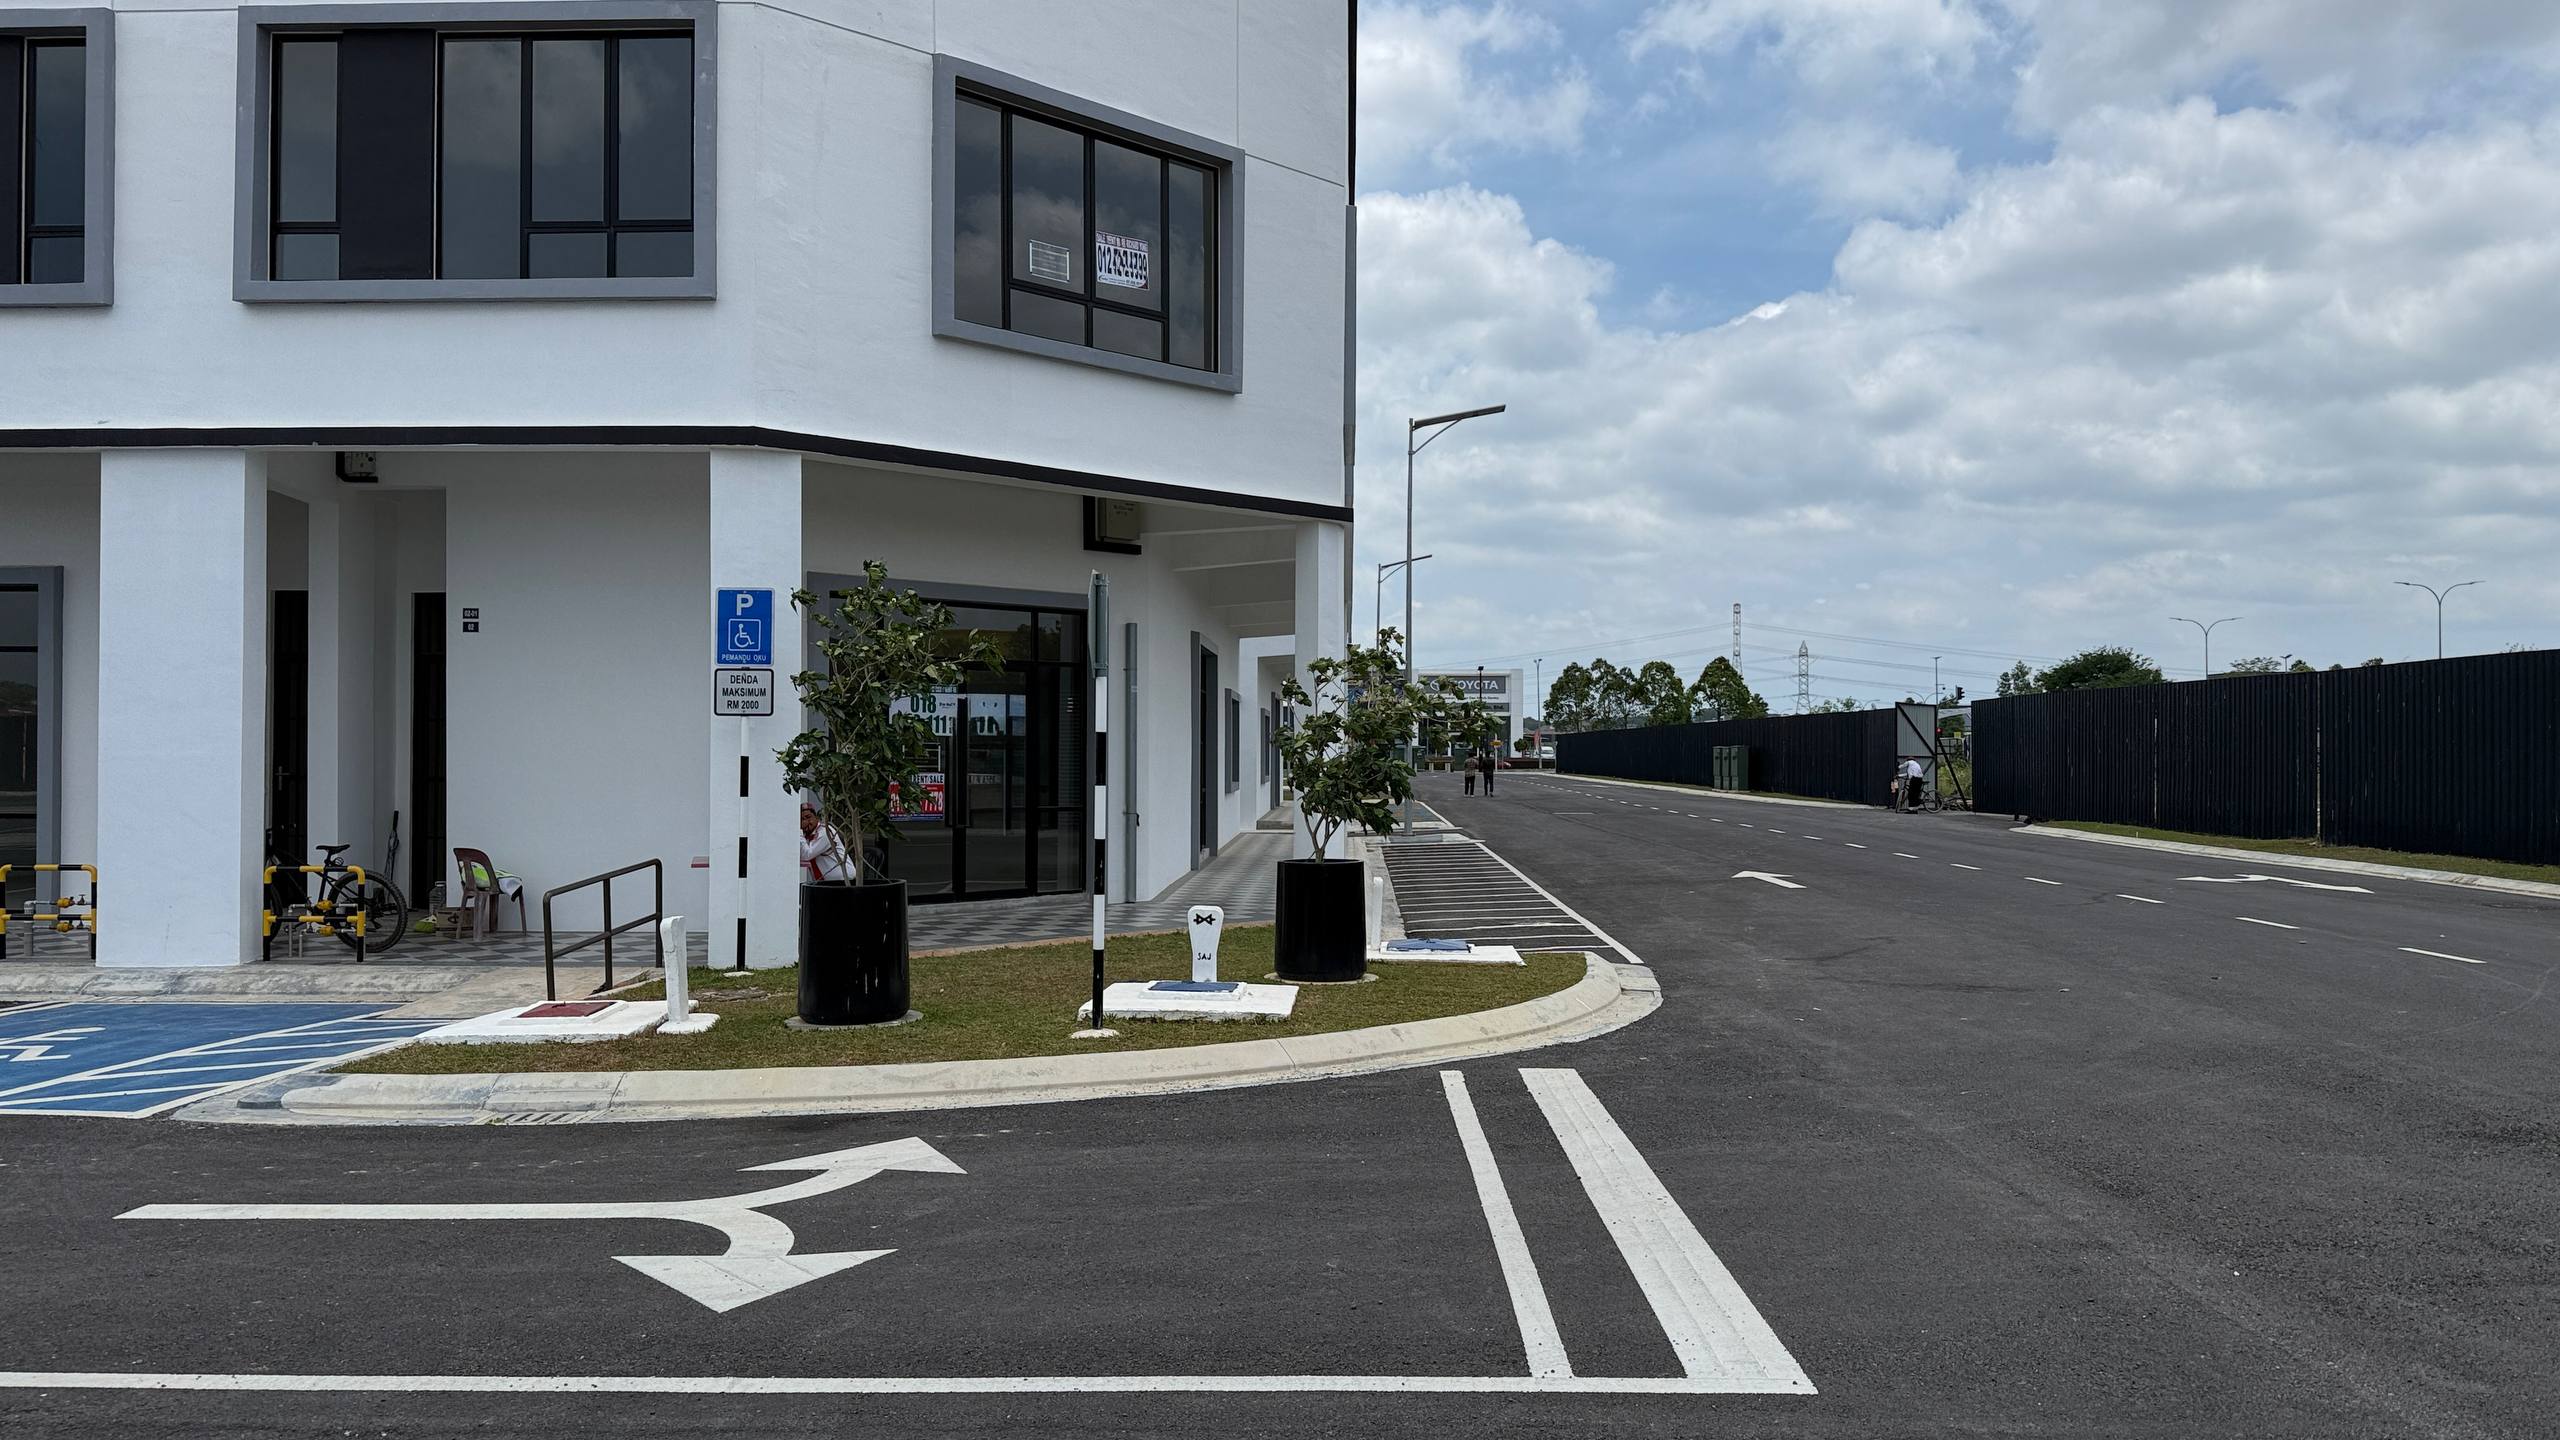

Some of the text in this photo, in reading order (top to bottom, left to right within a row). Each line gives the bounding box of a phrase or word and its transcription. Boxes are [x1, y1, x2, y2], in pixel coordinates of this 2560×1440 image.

[736, 593, 754, 616] P
[721, 653, 751, 661] PEMANDU
[730, 674, 759, 684] DENDA
[721, 687, 767, 697] MAKSIMUM
[727, 700, 759, 710] RM 2000
[910, 694, 937, 714] 018
[1197, 952, 1212, 961] SAJ
